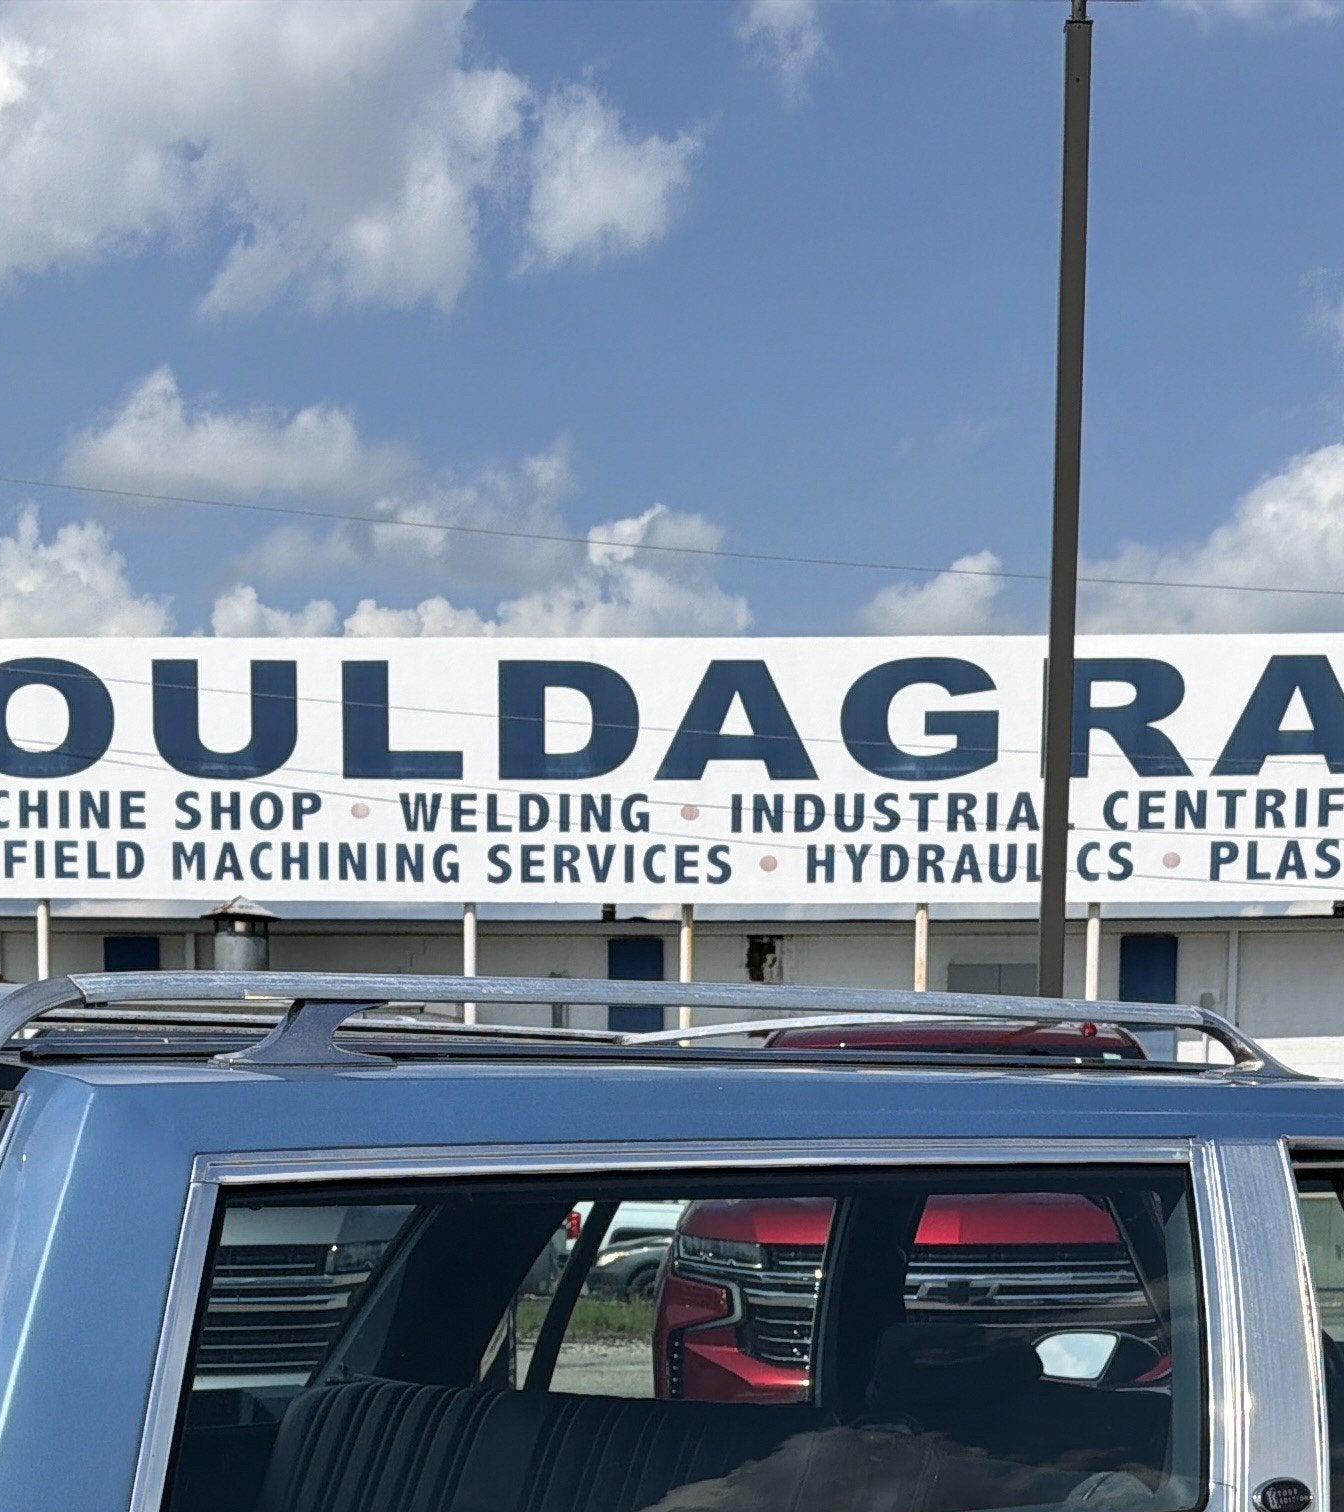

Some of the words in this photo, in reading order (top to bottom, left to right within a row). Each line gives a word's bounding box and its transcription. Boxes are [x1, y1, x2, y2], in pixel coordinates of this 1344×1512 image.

[174, 790, 323, 831] SHOP
[399, 792, 651, 834] WELDING
[730, 791, 1075, 834] INDUSTRIA
[3, 840, 146, 880] FIELD
[171, 841, 460, 883] MACHINING
[486, 843, 733, 885] SERVICES
[805, 841, 1134, 885] HYDRAULCS
